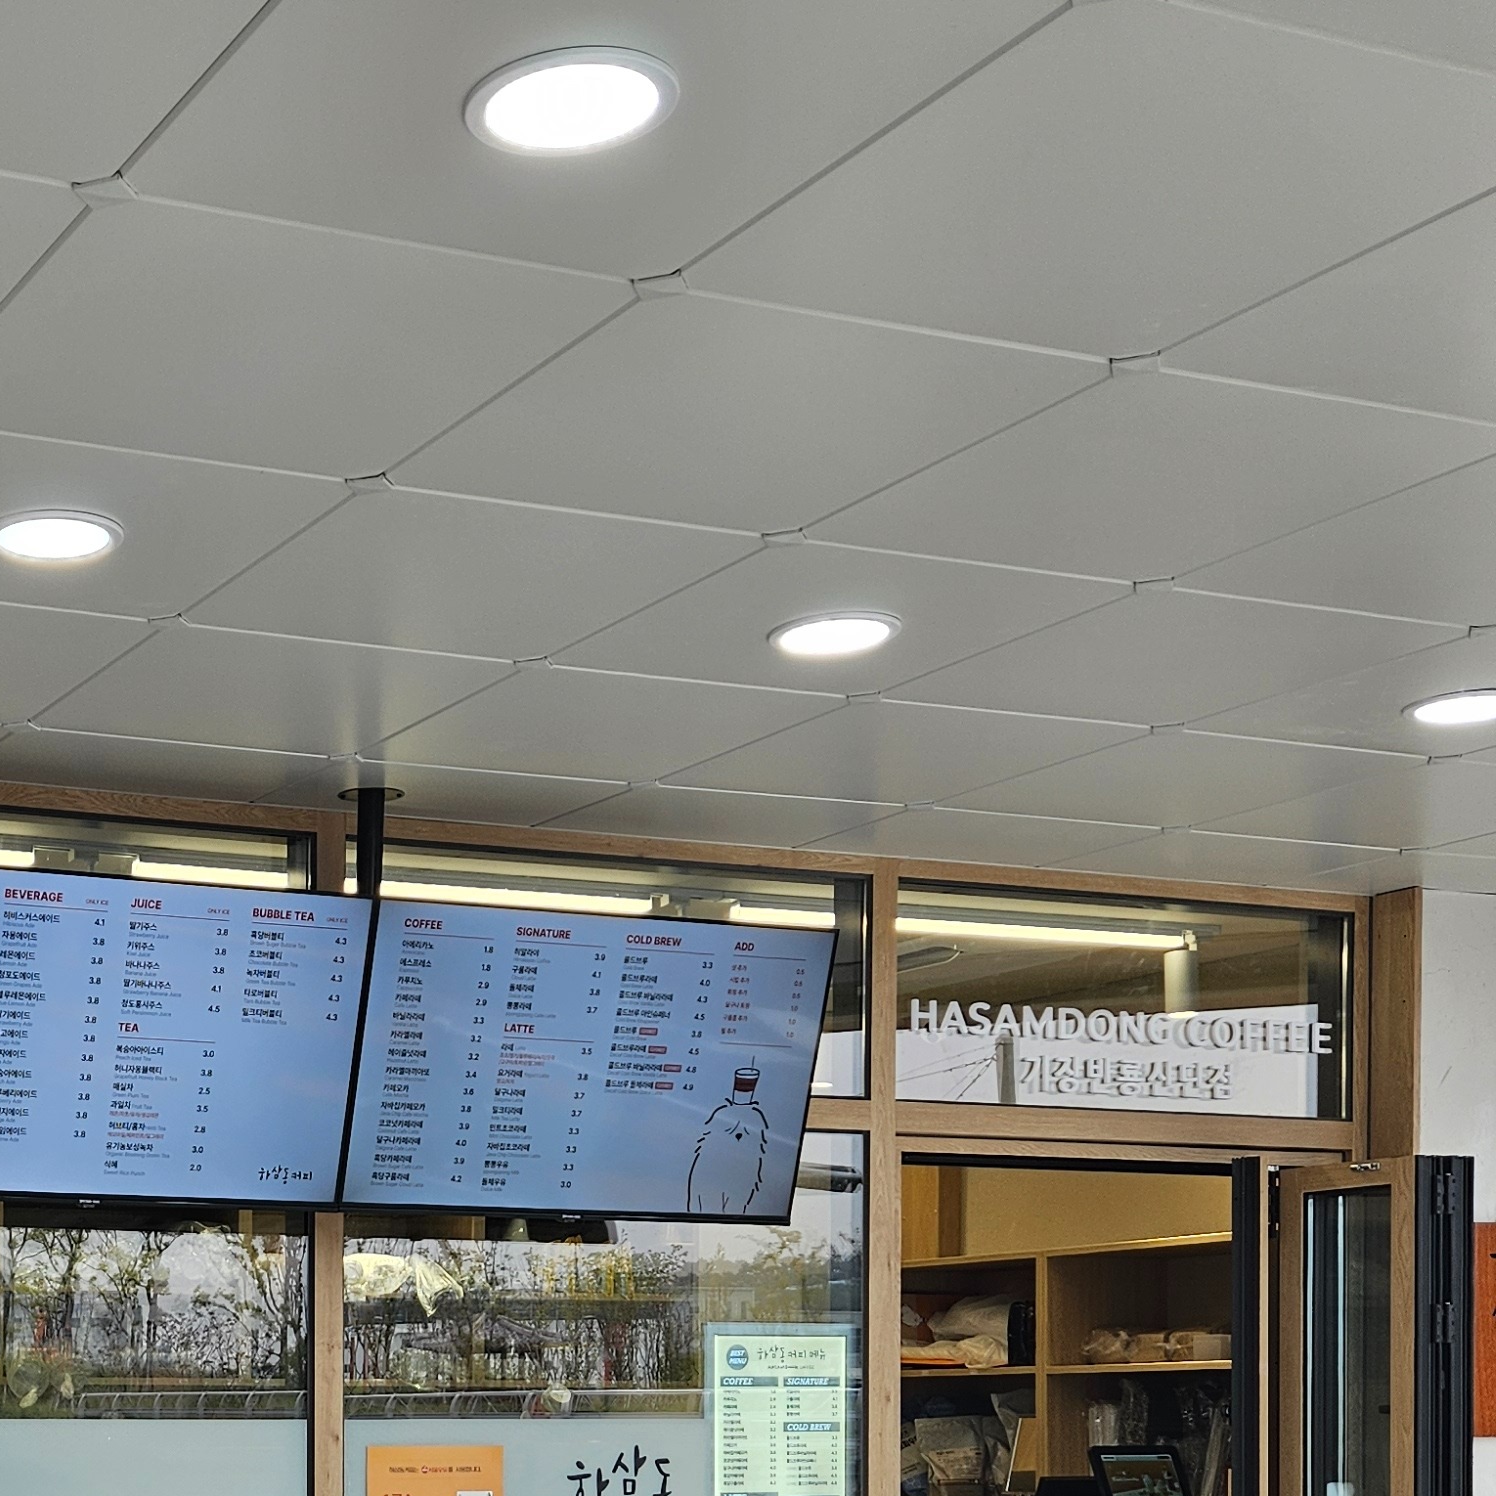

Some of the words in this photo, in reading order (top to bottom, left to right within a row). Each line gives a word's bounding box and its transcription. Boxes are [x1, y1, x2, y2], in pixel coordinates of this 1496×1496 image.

[4, 889, 63, 902] BEVERAGE
[131, 899, 162, 910] JUICE
[252, 908, 292, 920] BUBBLE
[295, 911, 315, 922] TEA
[404, 918, 443, 929] COFFEE
[516, 927, 571, 939] SIGNATURE
[93, 938, 105, 946] 3.8
[626, 934, 652, 944] COLD
[654, 936, 682, 946] BREW
[734, 942, 755, 951] ADD
[215, 948, 227, 956] 3.8
[211, 985, 222, 993] 4.1
[87, 997, 100, 1005] 3.8
[208, 1005, 220, 1013] 4.5
[85, 1016, 97, 1024] 3.8
[118, 1022, 139, 1033] TEA
[504, 1023, 535, 1034] LATTE
[910, 998, 1173, 1047] HASAMDONG
[1185, 1015, 1333, 1055] COFFEE
[83, 1034, 95, 1042] 3.8
[81, 1054, 94, 1062] 3.8
[203, 1050, 215, 1058] 3.0
[1019, 1055, 1232, 1101] 기장반룡산단점
[198, 1087, 210, 1095] 2.5
[258, 1164, 312, 1185] 하삼동커피
